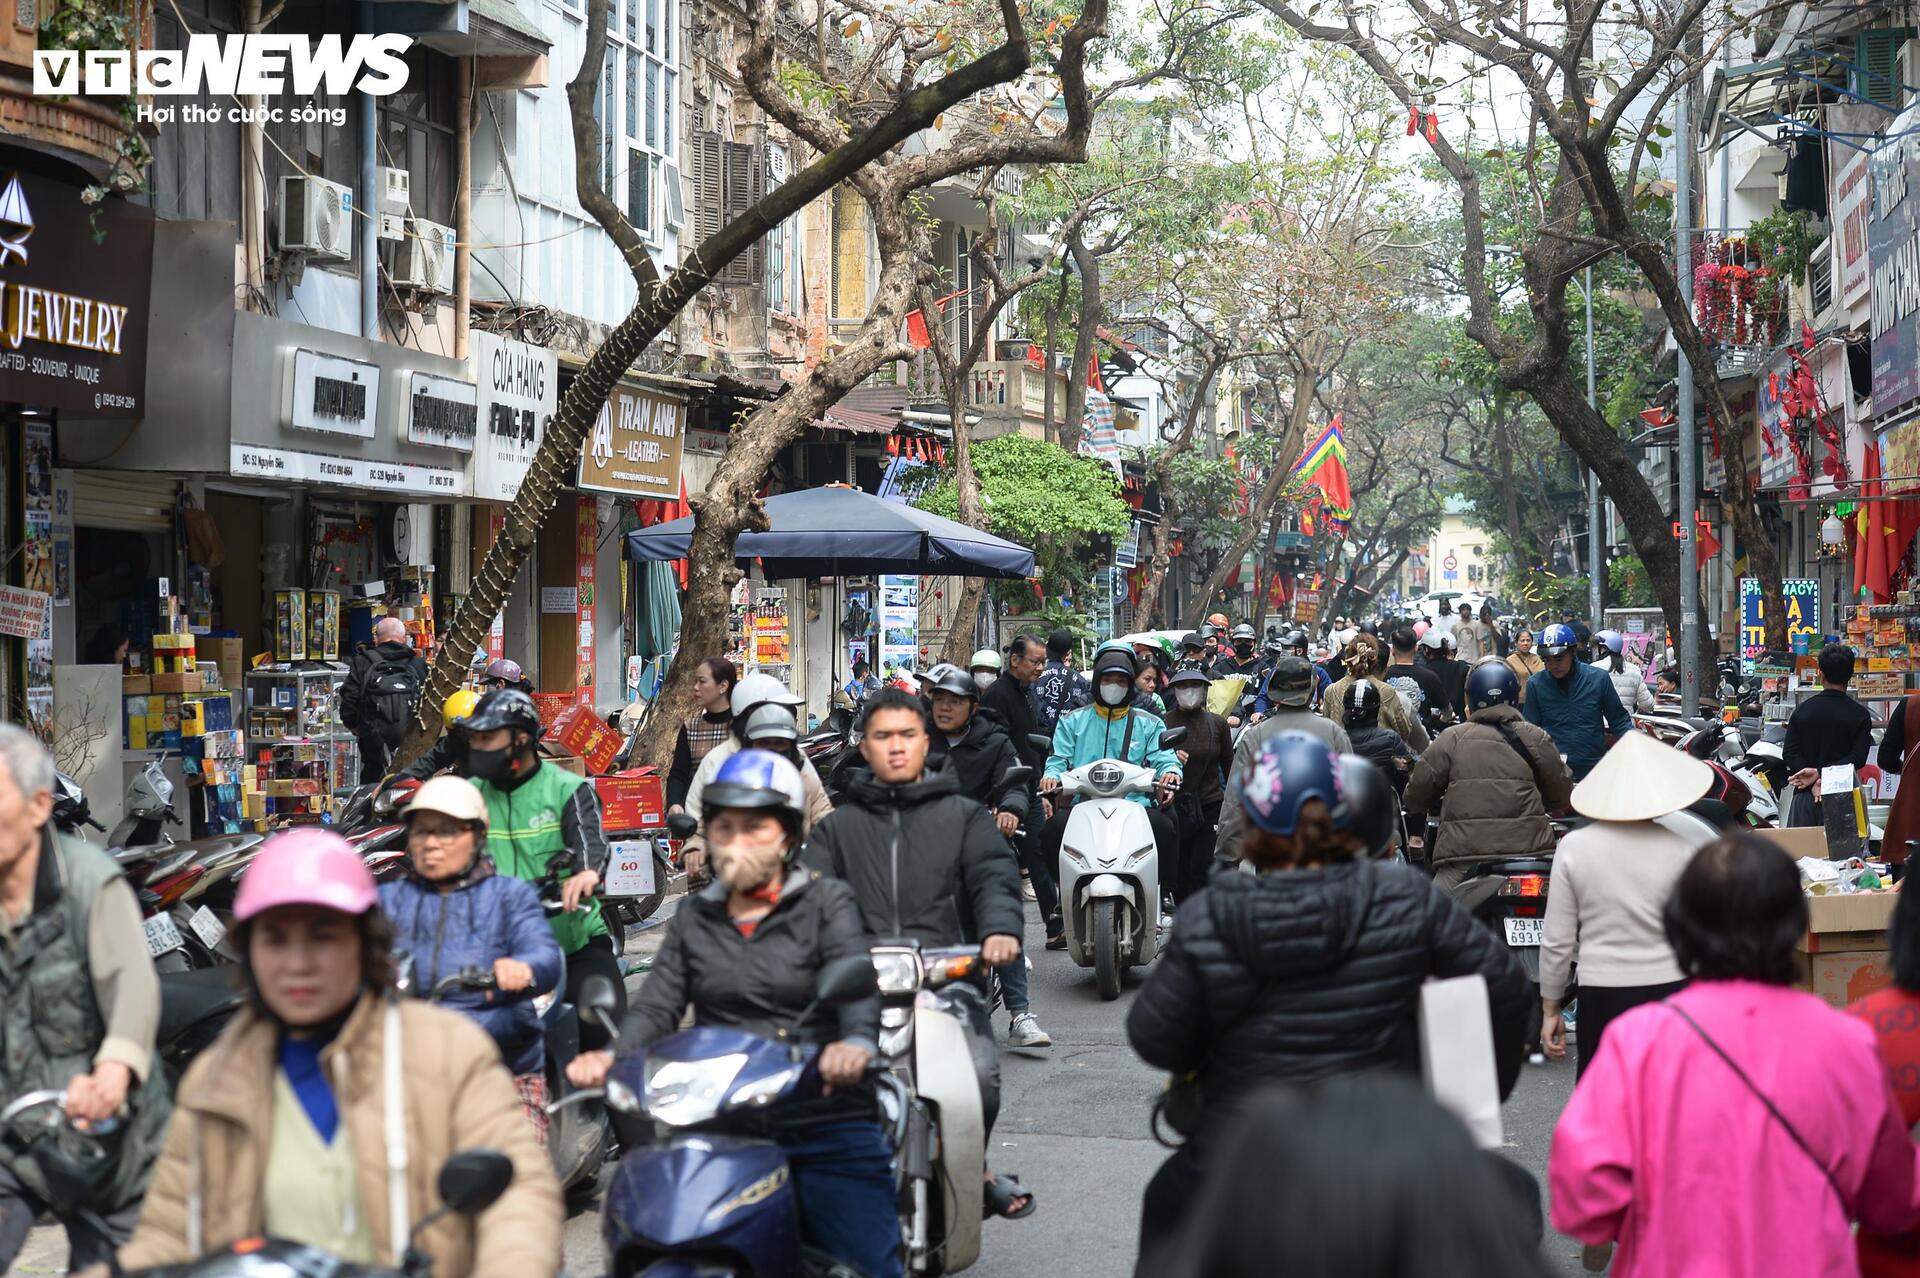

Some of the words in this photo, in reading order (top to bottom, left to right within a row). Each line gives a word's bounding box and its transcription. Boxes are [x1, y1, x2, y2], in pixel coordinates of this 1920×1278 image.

[10, 285, 128, 354] JEWELRY
[32, 357, 68, 378] SOUVENIR
[74, 365, 100, 384] UNIQUE
[493, 340, 514, 393] CỬA
[517, 344, 544, 401] HÀNG
[652, 402, 676, 438] ANH
[517, 455, 532, 465] JEWEL
[628, 440, 660, 464] LEATHER
[57, 489, 68, 515] 52
[397, 518, 406, 554] P
[621, 862, 637, 871] 60
